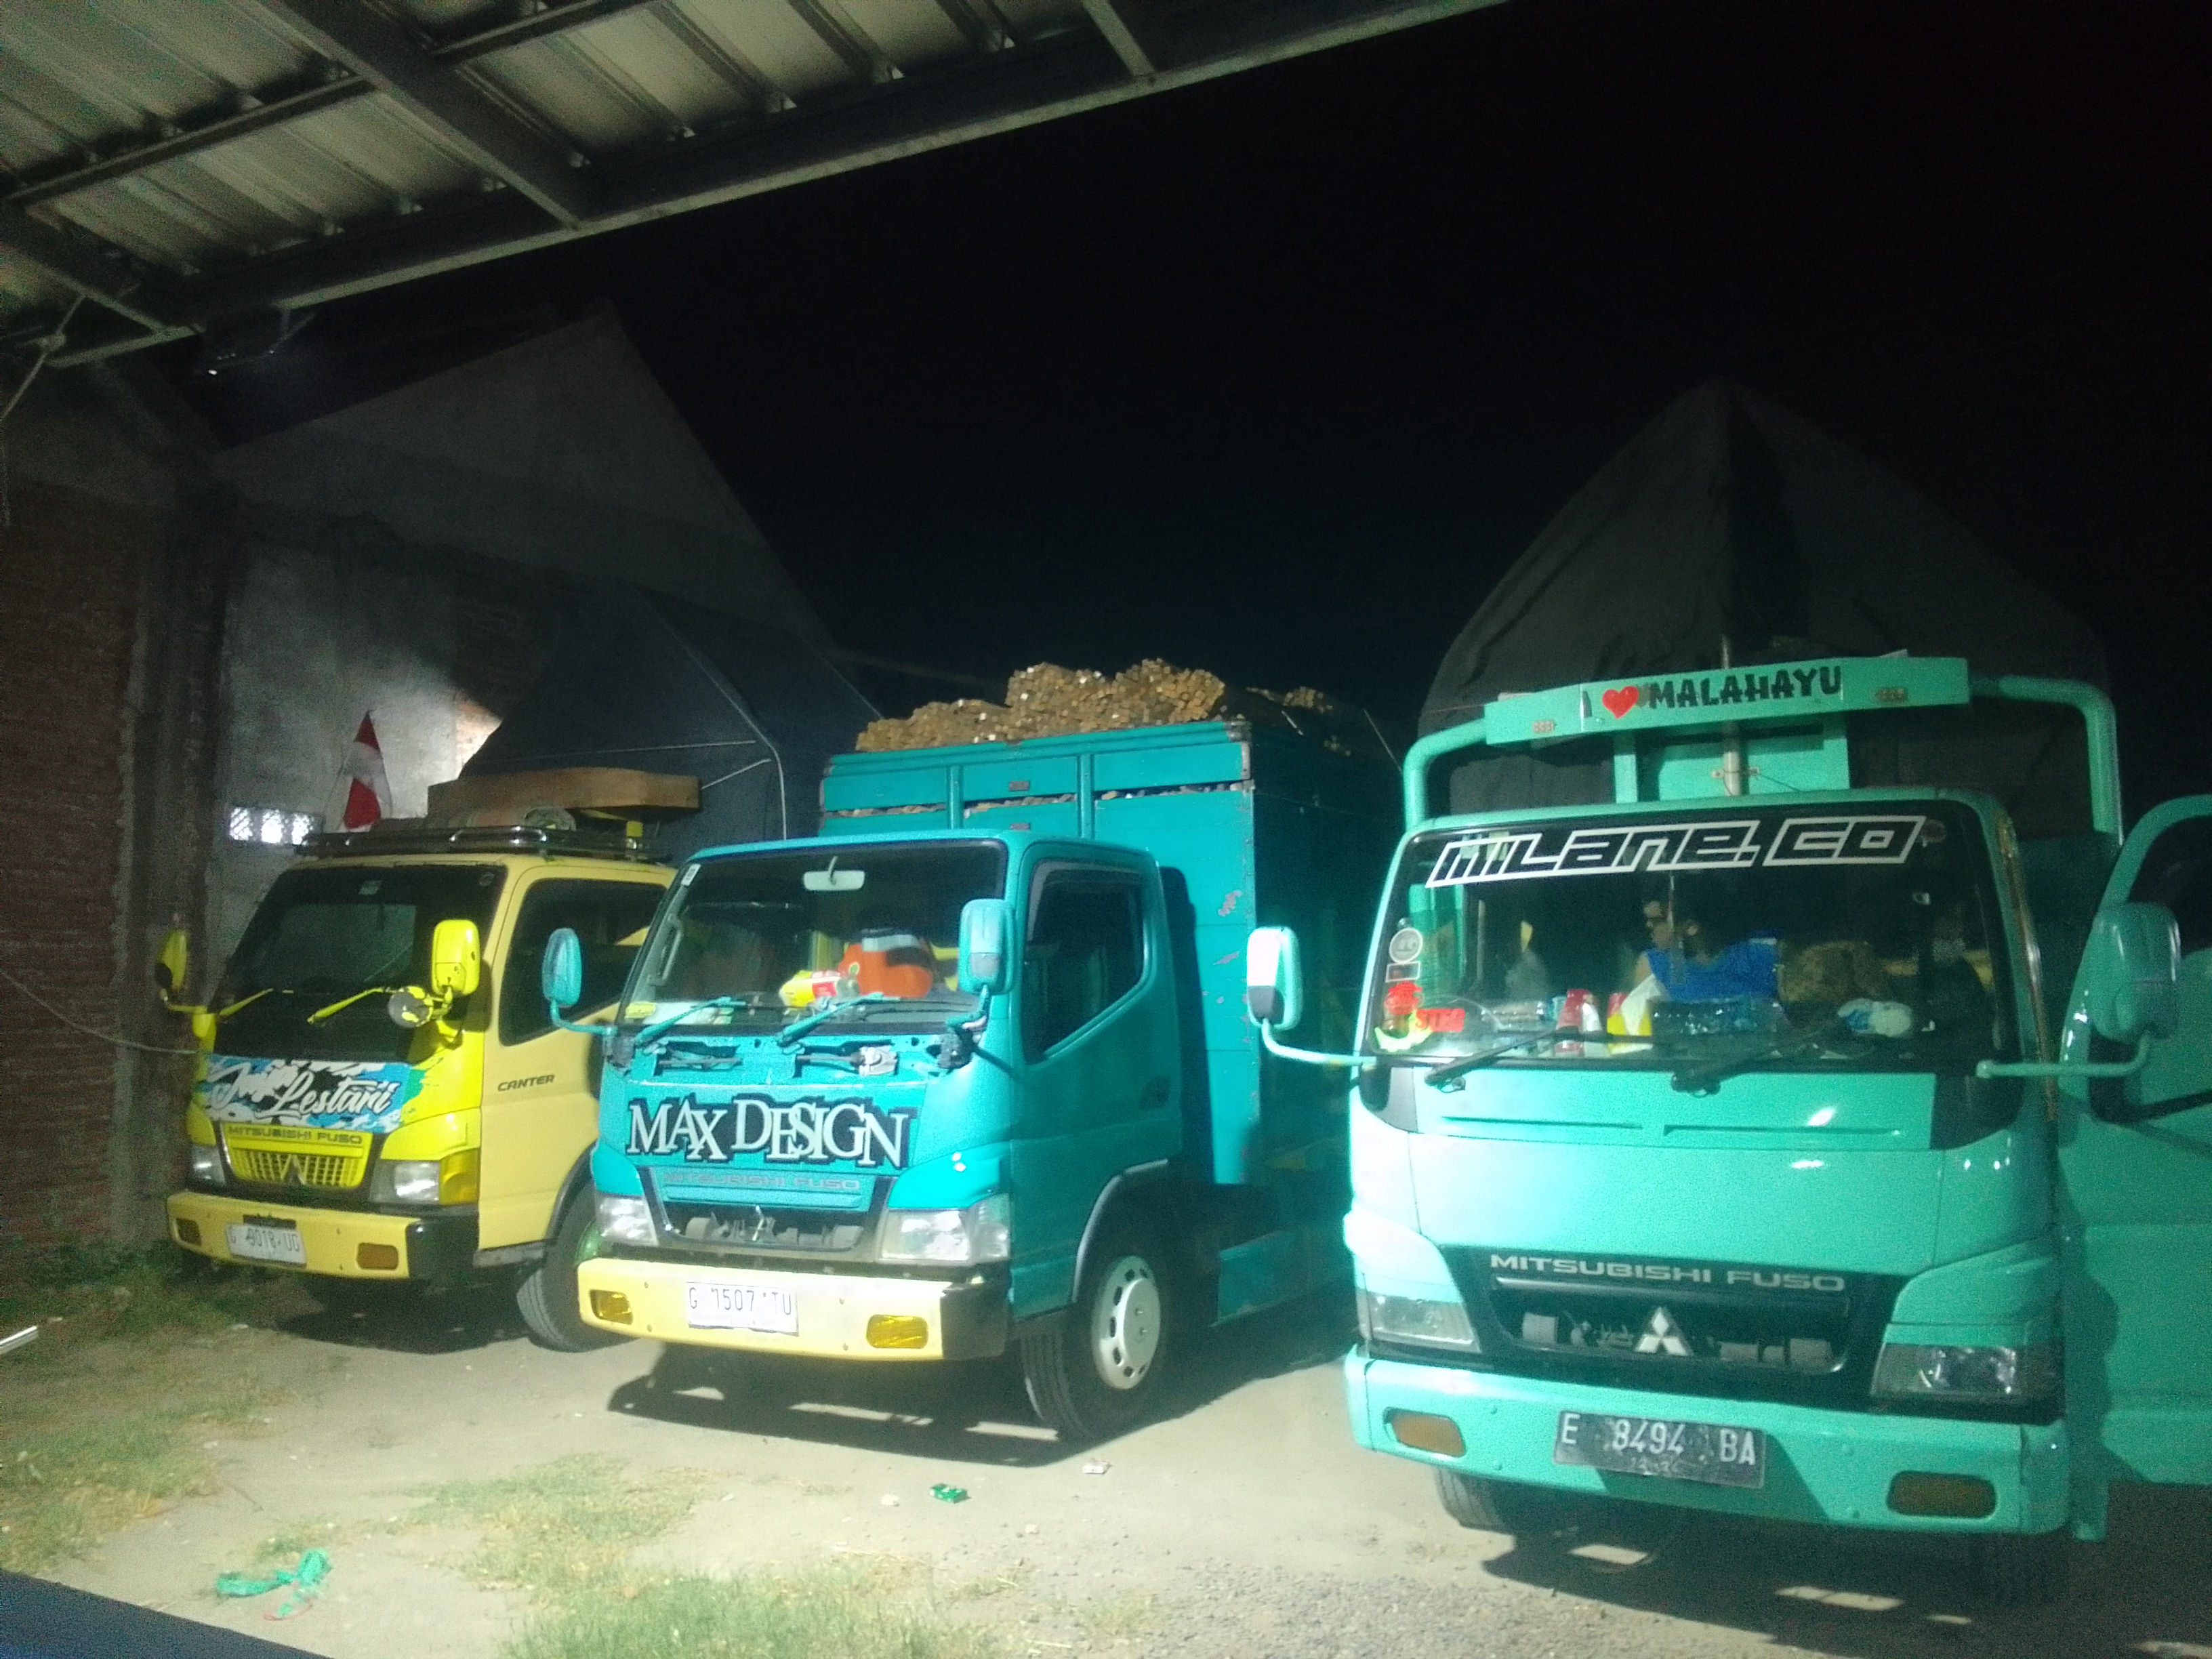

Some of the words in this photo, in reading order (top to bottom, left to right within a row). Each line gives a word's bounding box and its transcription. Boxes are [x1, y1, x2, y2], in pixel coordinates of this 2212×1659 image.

[1648, 665, 1842, 710] MALAHAYU
[253, 1071, 401, 1119] Lestari
[497, 1073, 555, 1092] CANTER
[228, 1126, 312, 1140] MITSUBISHI
[317, 1132, 363, 1145] FUSO
[627, 1097, 730, 1161] MAX
[731, 1096, 912, 1168] DESIGN
[664, 1172, 786, 1187] MITSUBISHI
[794, 1176, 860, 1191] FUSO
[1491, 1254, 1711, 1284] MITSUBISHI
[1727, 1270, 1845, 1292] FUSO
[689, 1286, 698, 1309] G
[711, 1288, 754, 1313] 1507
[1561, 1412, 1581, 1445] E
[1611, 1418, 1686, 1455] 8494
[1719, 1427, 1756, 1466] BA
